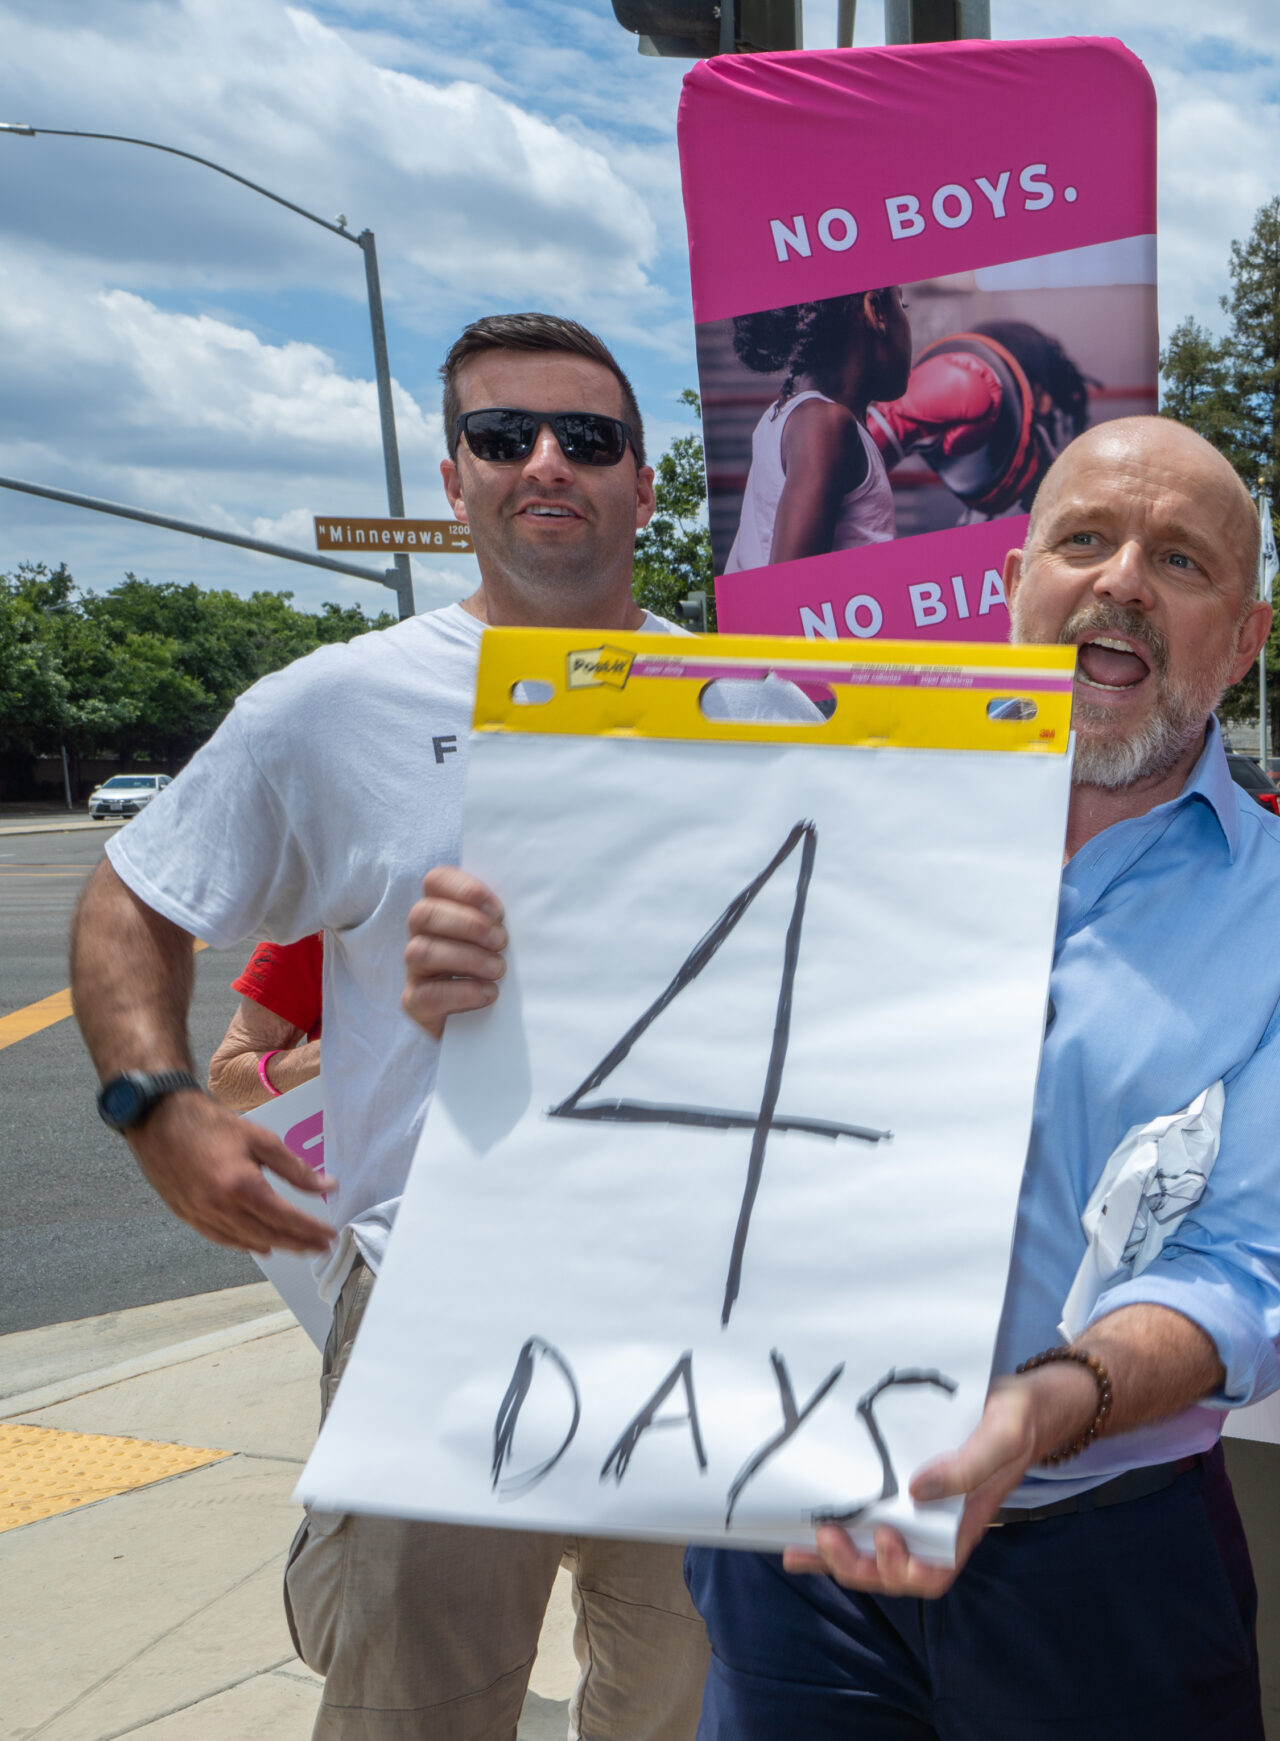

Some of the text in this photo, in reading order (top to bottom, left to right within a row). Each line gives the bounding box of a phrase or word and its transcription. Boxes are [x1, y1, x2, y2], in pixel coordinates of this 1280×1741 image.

[770, 164, 1077, 262] NO BOYS.
[319, 525, 326, 534] N
[329, 525, 443, 545] Minnewawa
[800, 569, 1008, 641] NO BIA
[432, 735, 457, 764] F
[546, 818, 896, 1332] 4
[491, 1334, 958, 1531] DAYS
